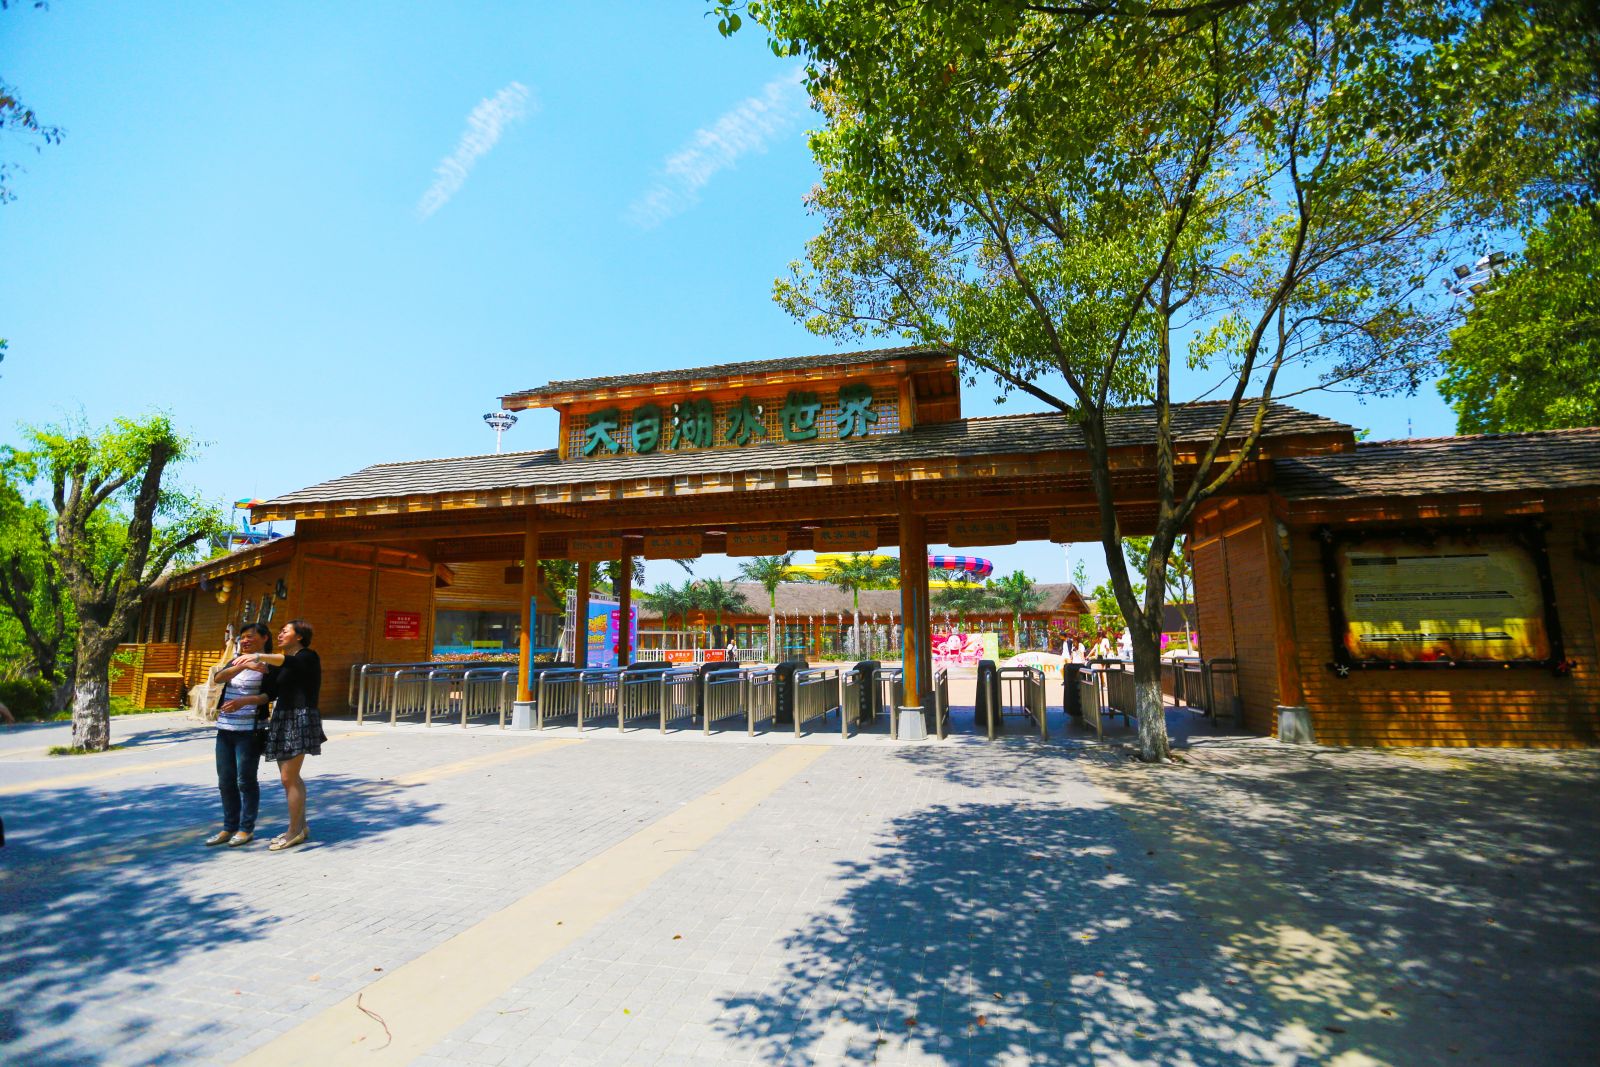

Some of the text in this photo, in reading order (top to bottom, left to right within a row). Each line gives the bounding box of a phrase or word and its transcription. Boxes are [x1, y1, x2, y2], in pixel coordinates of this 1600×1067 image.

[583, 383, 879, 456] 天目湖水世界
